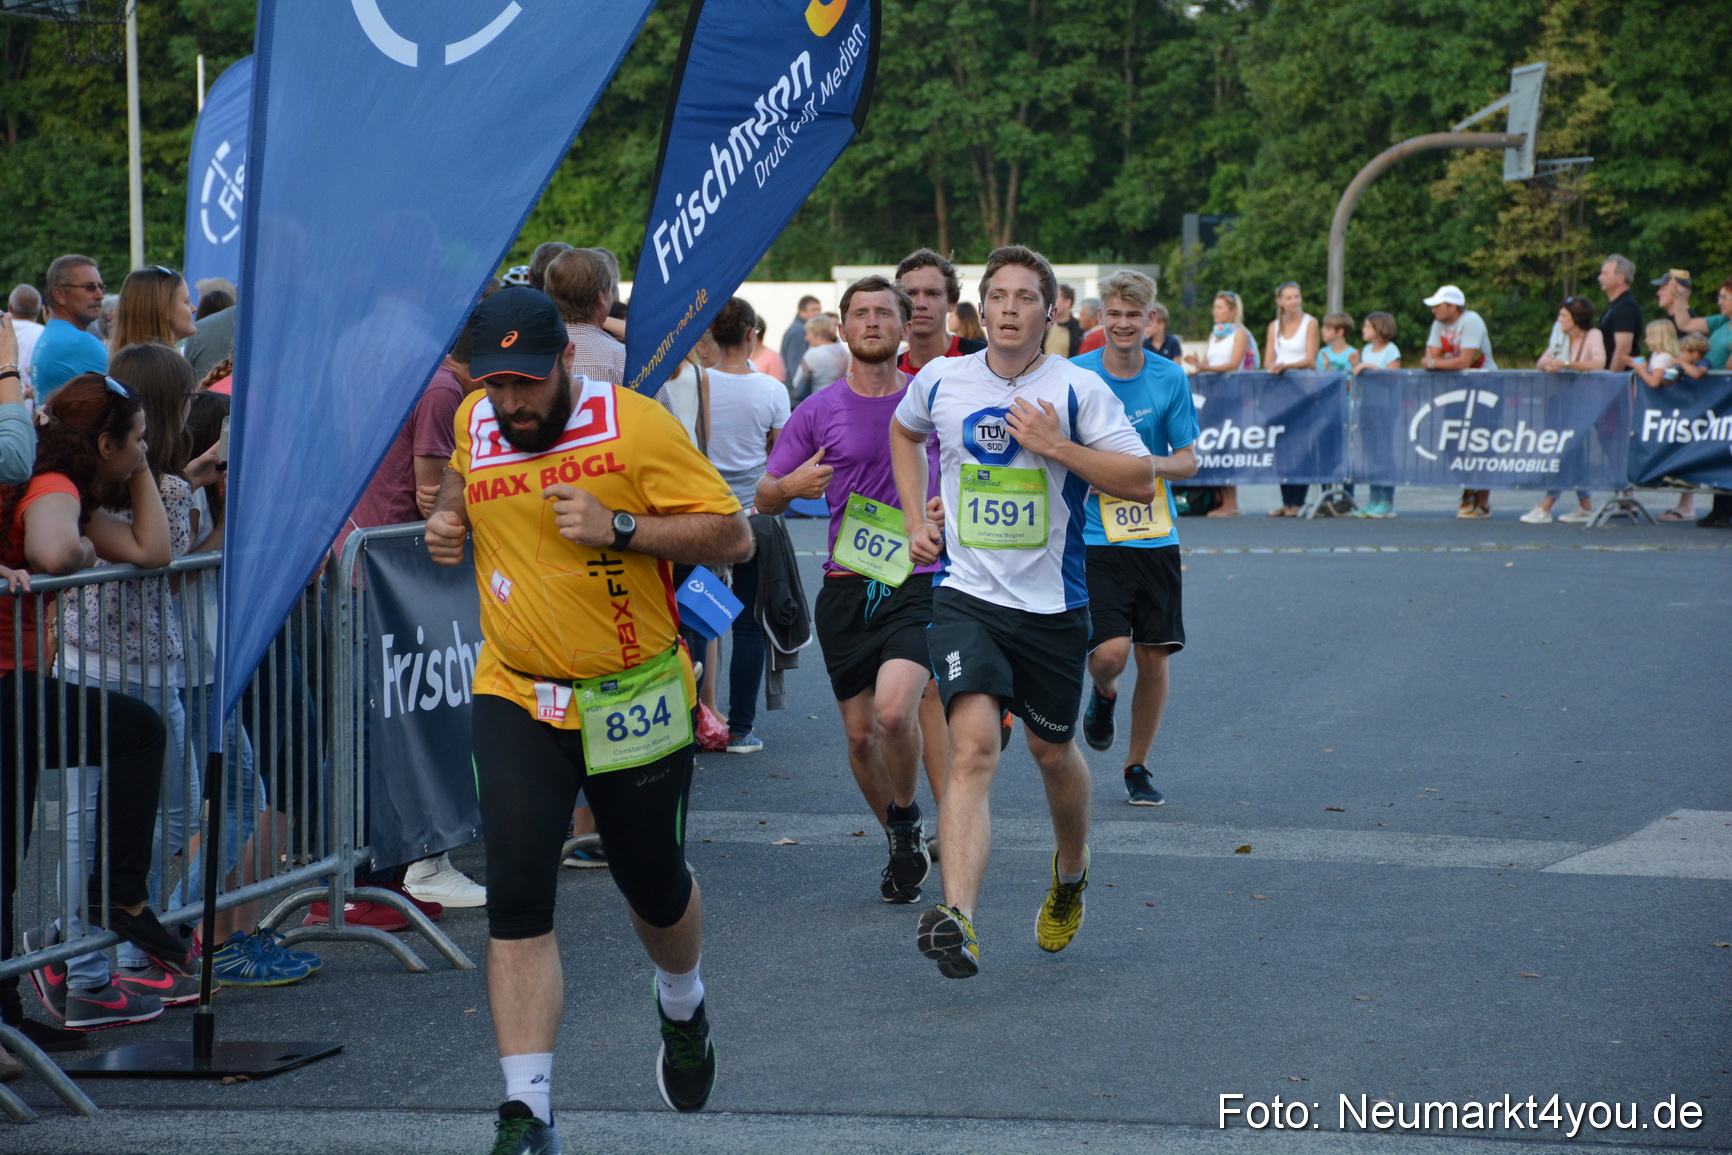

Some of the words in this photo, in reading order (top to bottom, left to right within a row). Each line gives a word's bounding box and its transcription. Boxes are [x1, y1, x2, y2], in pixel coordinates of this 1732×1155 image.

[754, 125, 794, 189] Druck
[820, 22, 867, 105] Medien
[652, 50, 813, 285] Frischmann
[978, 425, 1006, 439] TÜV
[987, 442, 1003, 451] SÜD
[1193, 418, 1286, 451] cher
[1438, 419, 1575, 454] Fischer
[467, 473, 531, 505] MAX
[539, 452, 627, 491] BÖGL
[1450, 457, 1560, 473] AUTOMOBILE
[967, 497, 1035, 527] 1591
[1115, 504, 1153, 526] 801
[853, 527, 903, 562] 667
[703, 588, 734, 620] Lebenshilfe
[605, 694, 672, 742] 834
[613, 742, 652, 756] Constantin
